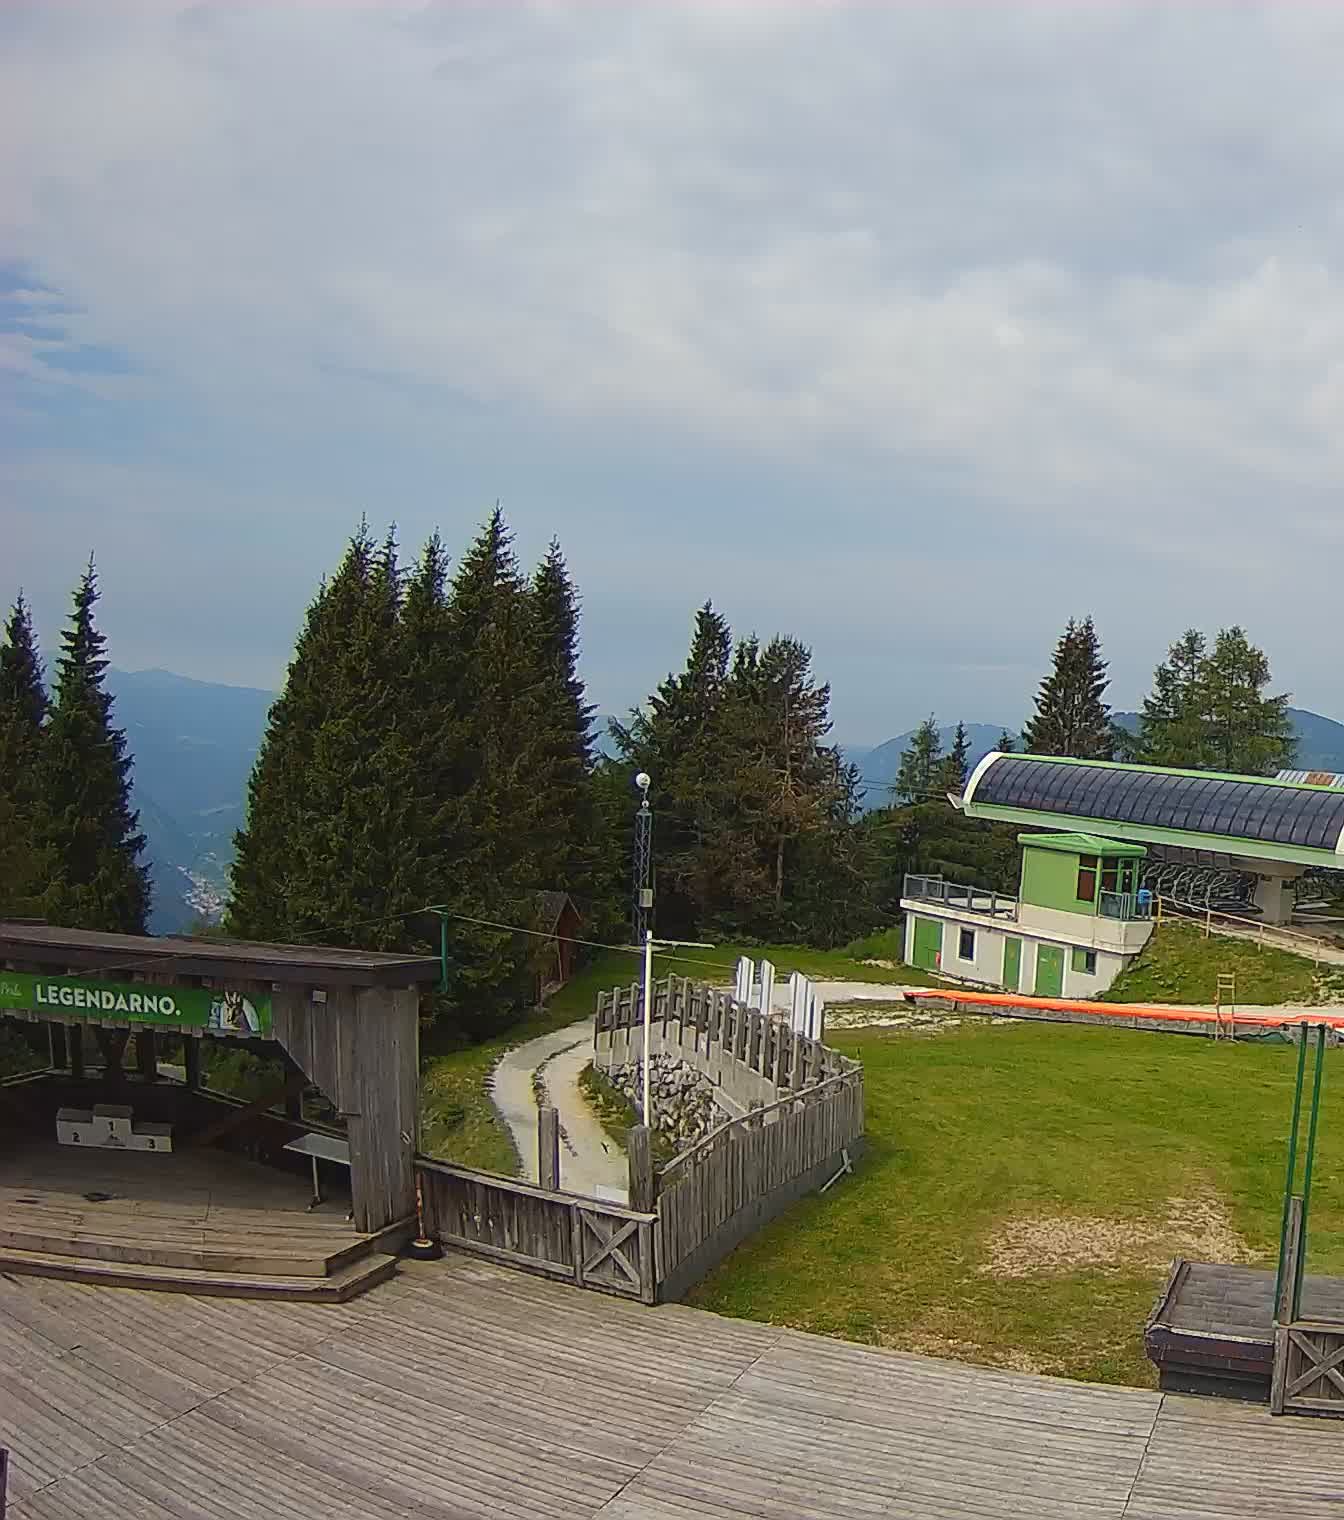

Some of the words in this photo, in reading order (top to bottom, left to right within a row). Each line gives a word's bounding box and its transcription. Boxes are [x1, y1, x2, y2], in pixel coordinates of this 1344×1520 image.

[36, 984, 182, 1016] LEGENDARNO.
[72, 1132, 80, 1142] 2
[148, 1139, 156, 1149] 3
